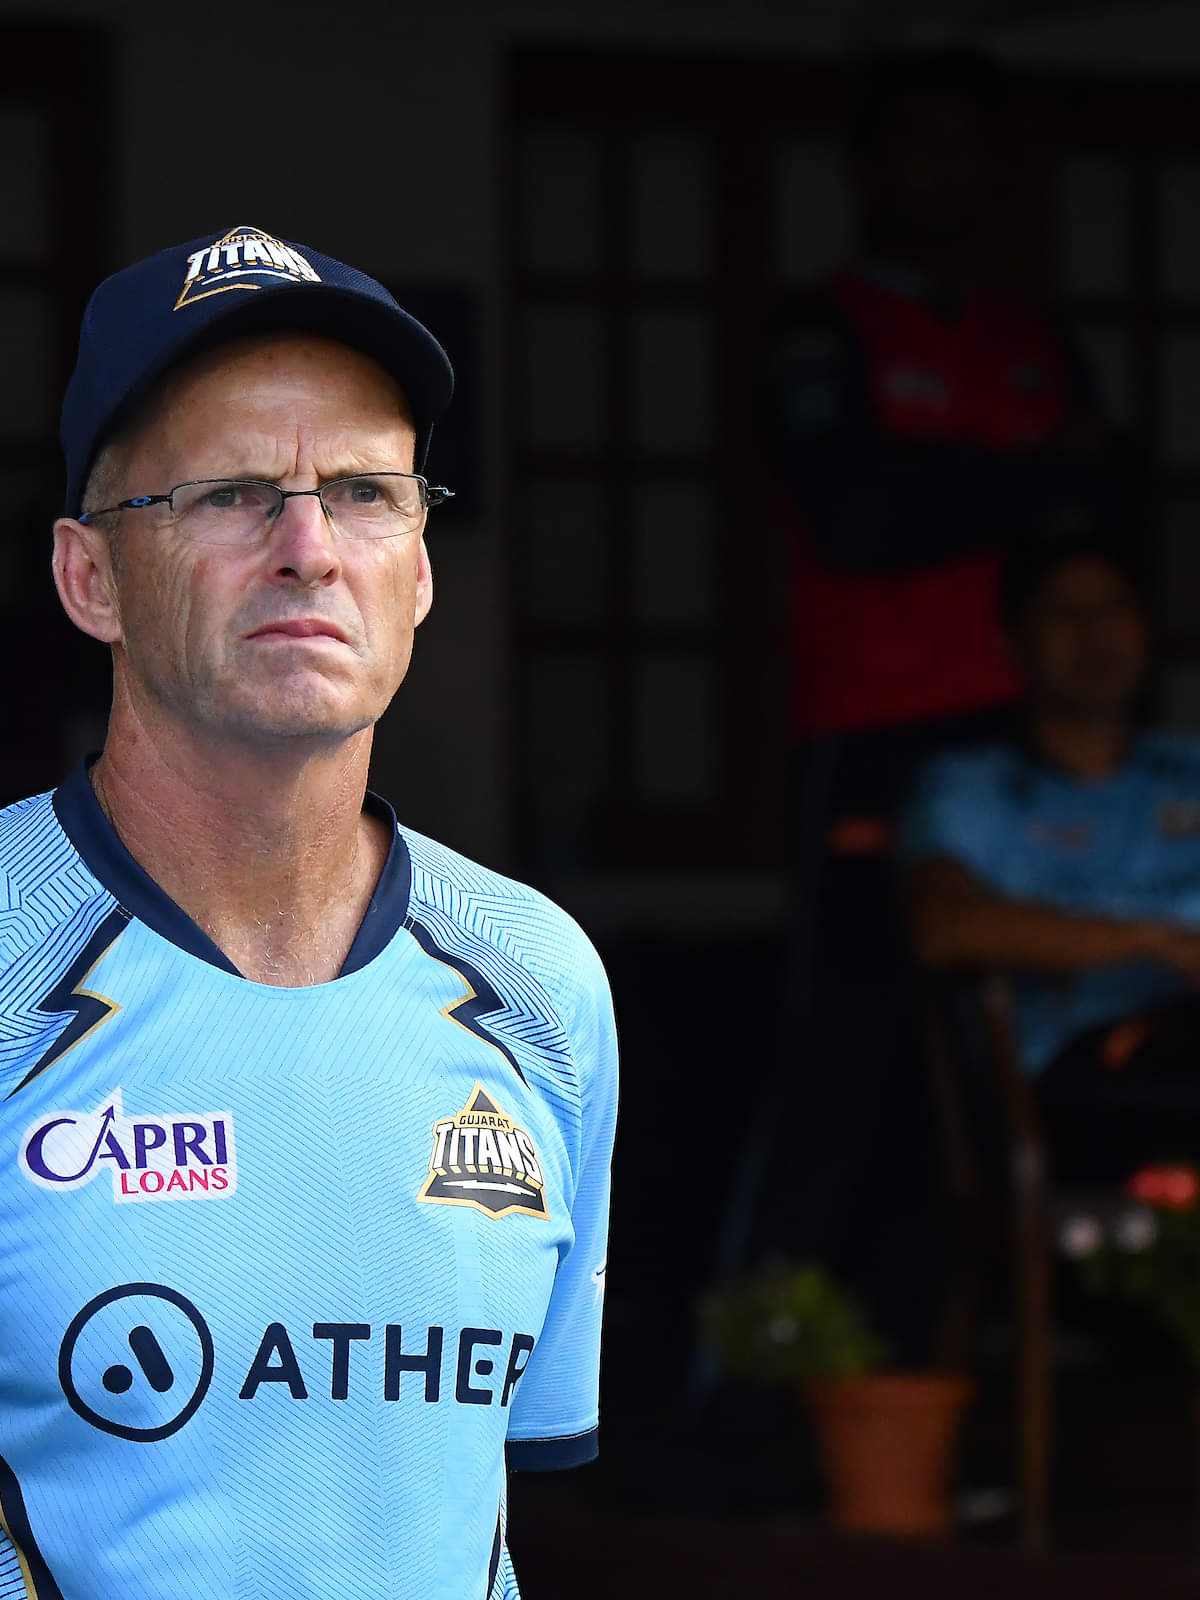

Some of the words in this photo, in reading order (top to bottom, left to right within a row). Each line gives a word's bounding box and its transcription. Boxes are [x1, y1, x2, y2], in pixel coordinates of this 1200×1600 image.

[185, 240, 322, 284] TITANS
[26, 1105, 228, 1182] CAPRI
[459, 1114, 511, 1130] GUJARAT
[120, 1167, 229, 1195] LOANS
[433, 1122, 544, 1188] TITANS
[238, 1322, 535, 1407] ATHER
